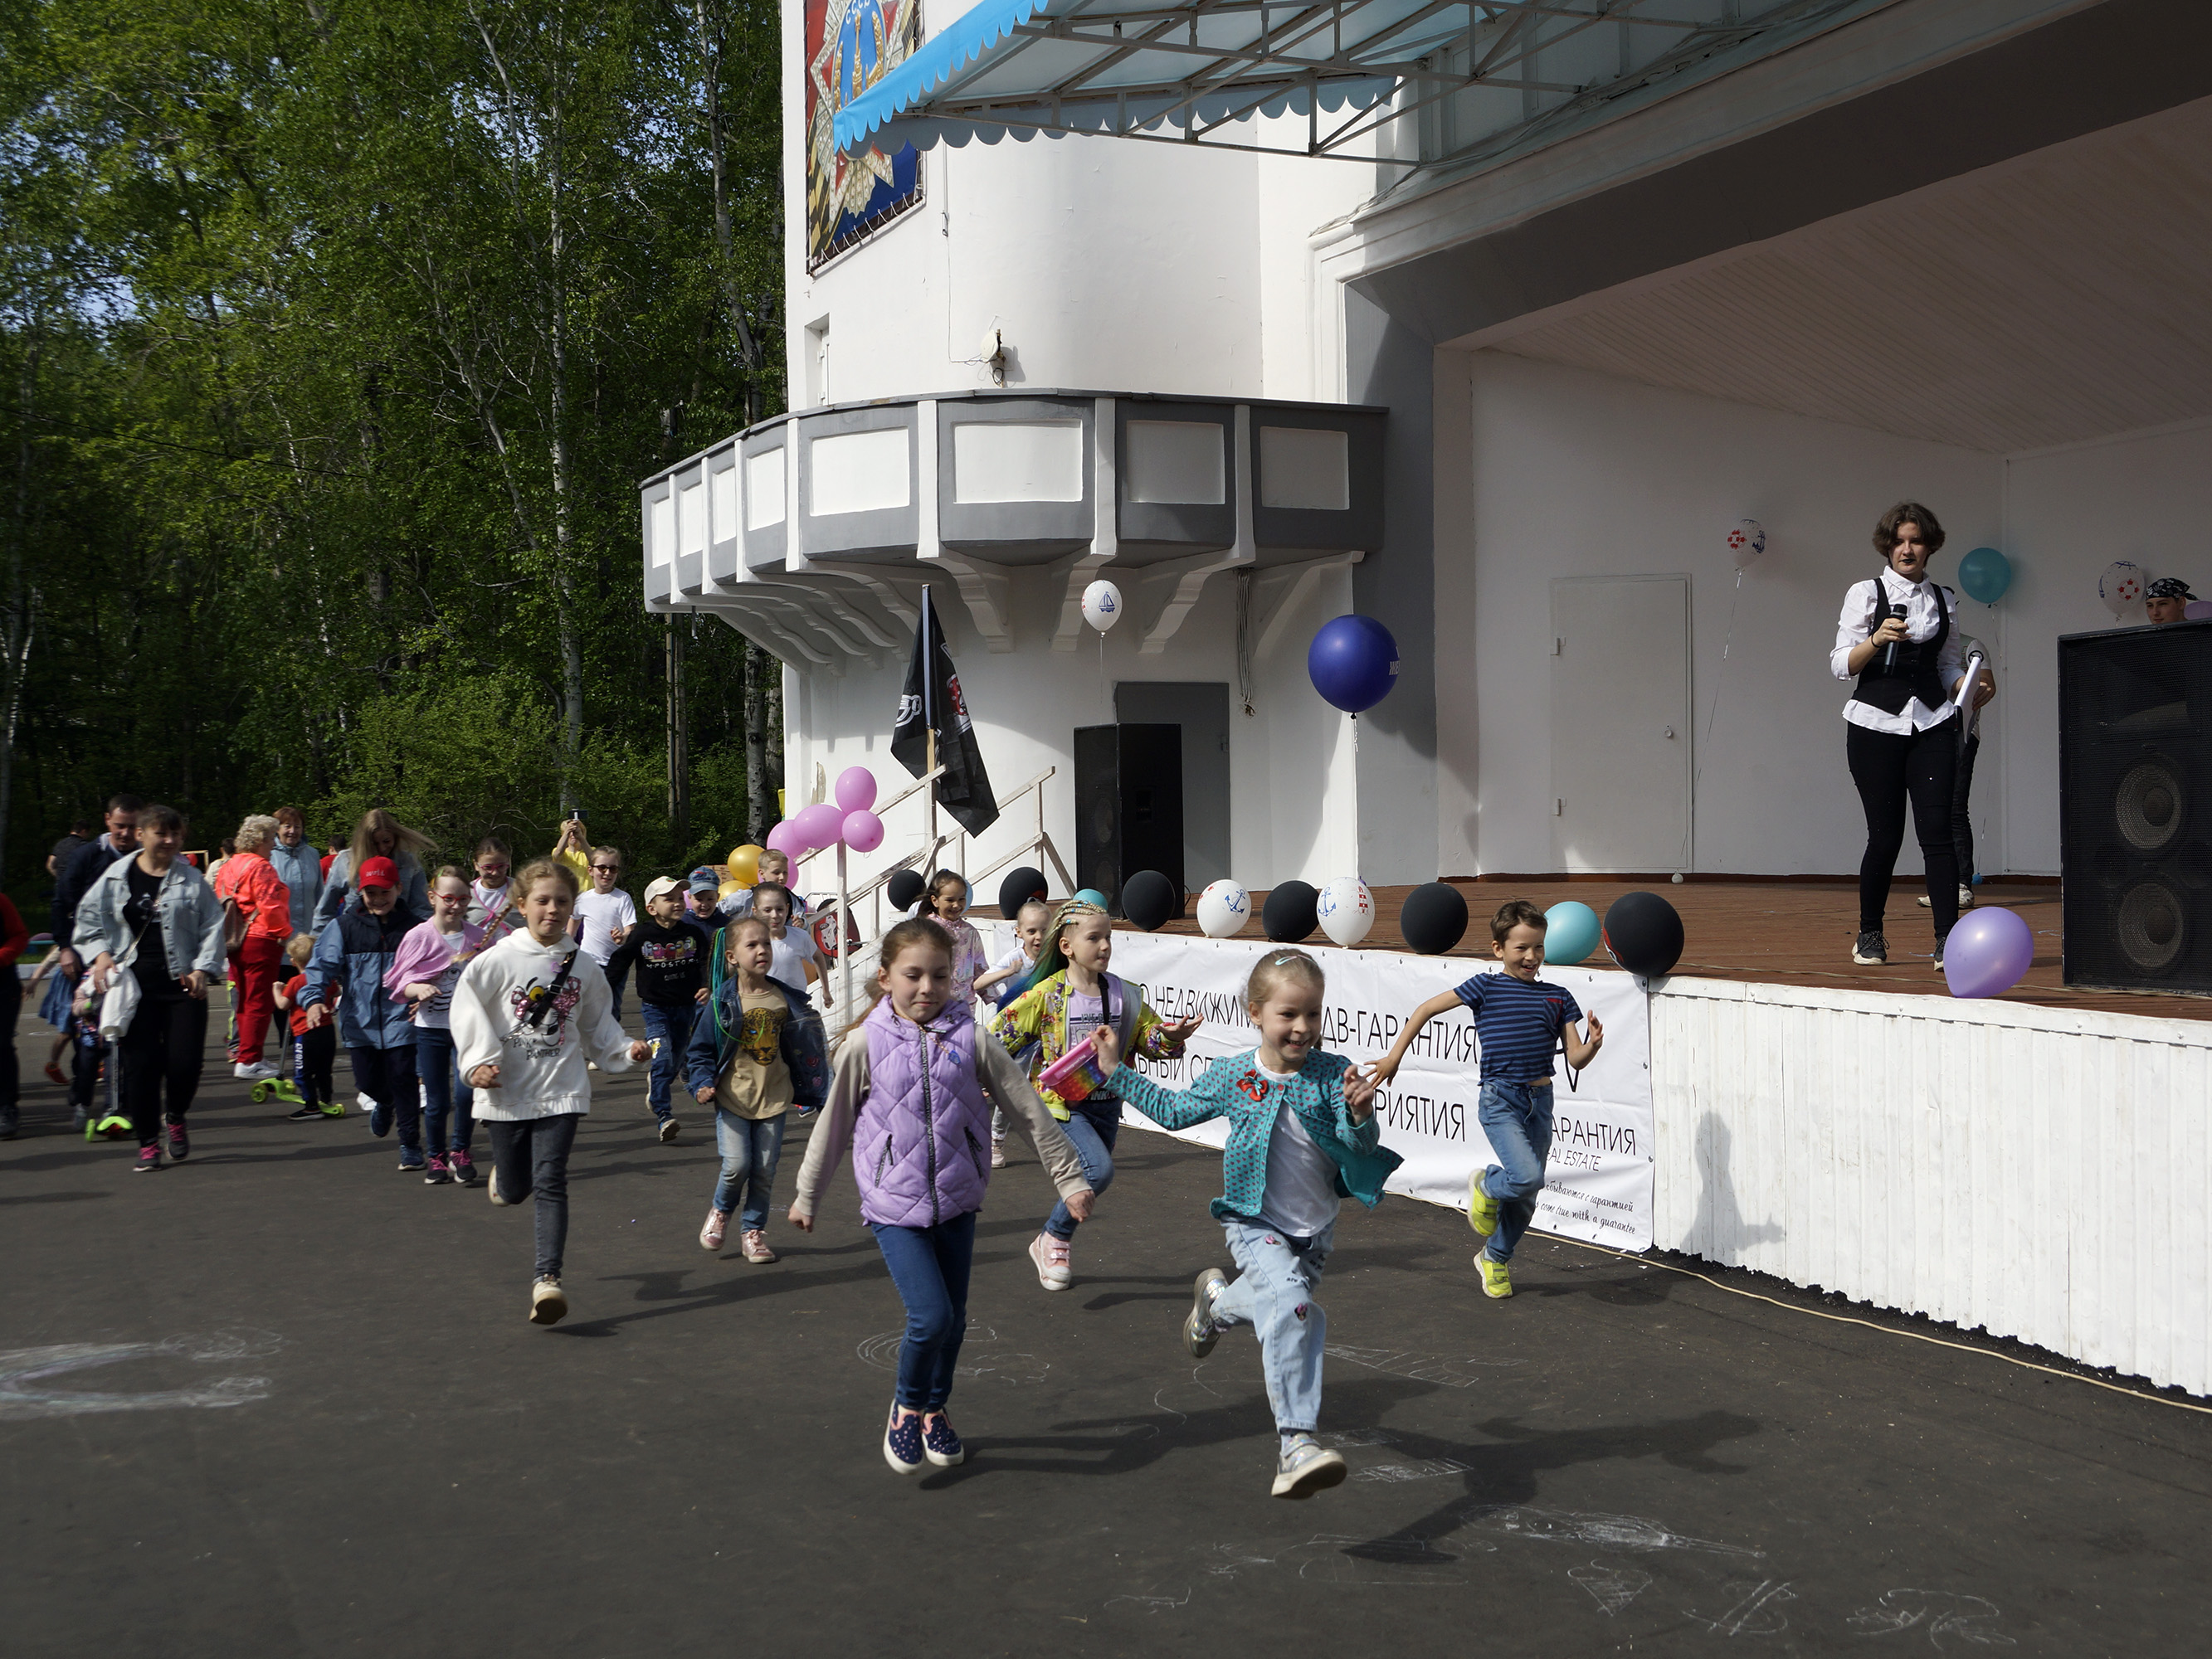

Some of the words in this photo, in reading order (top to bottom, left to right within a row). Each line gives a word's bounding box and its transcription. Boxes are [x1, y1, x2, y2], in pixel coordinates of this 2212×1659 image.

[1547, 1147, 1561, 1163] AL
[1564, 1151, 1601, 1171] ESTATE
[1546, 1180, 1584, 1199] сбываются
[1590, 1195, 1634, 1212] гарантией
[1541, 1203, 1555, 1213] come
[1556, 1204, 1569, 1218] true
[1572, 1209, 1590, 1222] with
[1593, 1215, 1597, 1224] a
[1600, 1218, 1636, 1234] guarantee
